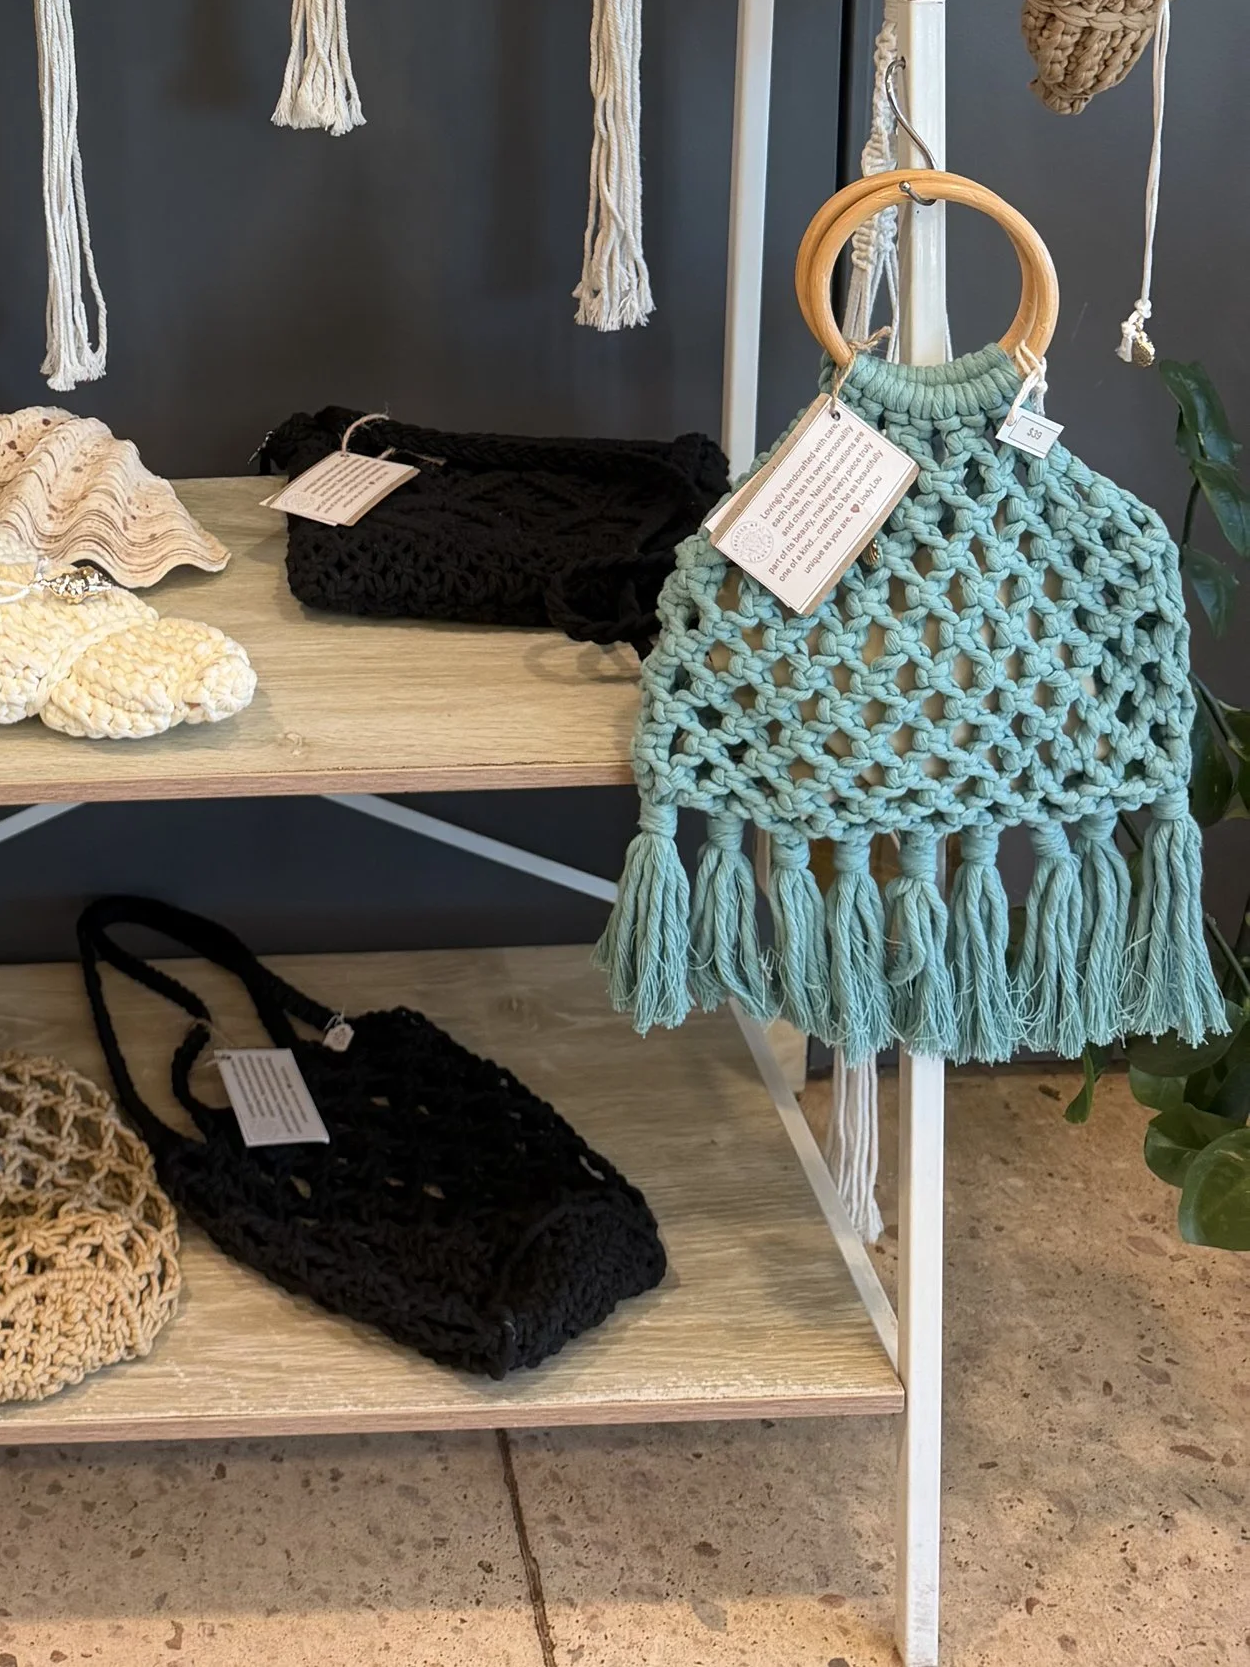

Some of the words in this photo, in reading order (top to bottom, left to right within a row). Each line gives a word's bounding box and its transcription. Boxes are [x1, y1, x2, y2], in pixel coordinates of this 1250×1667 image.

[759, 491, 786, 520] Lovingly
[781, 451, 816, 493] handcrafted
[813, 438, 827, 453] with
[824, 423, 841, 439] care,
[771, 509, 788, 528] each
[783, 496, 800, 511] bag
[793, 484, 808, 498] has
[804, 475, 816, 486] its
[812, 460, 827, 476] own
[823, 424, 854, 463] personality
[781, 520, 795, 537] and
[792, 500, 814, 524] charm.
[809, 472, 834, 500] Natural
[830, 442, 857, 474] variations
[853, 431, 865, 444] are
[1026, 427, 1043, 440] $39
[768, 558, 783, 575] part
[779, 549, 788, 560] of
[785, 542, 796, 553] its
[791, 518, 816, 544] beauty,
[812, 492, 836, 519] making
[831, 474, 850, 495] every
[845, 457, 862, 478] piece
[858, 441, 874, 458] truly
[779, 567, 792, 582] one
[789, 558, 798, 569] of
[816, 508, 839, 535] crafted
[834, 502, 844, 511] to
[840, 492, 852, 503] be
[849, 484, 859, 494] as
[854, 449, 884, 485] beautifully
[804, 549, 825, 574] unique
[822, 541, 832, 551] as
[829, 527, 843, 543] you
[839, 516, 853, 529] are.
[856, 487, 875, 506] Lindy
[868, 475, 883, 489] Lou
